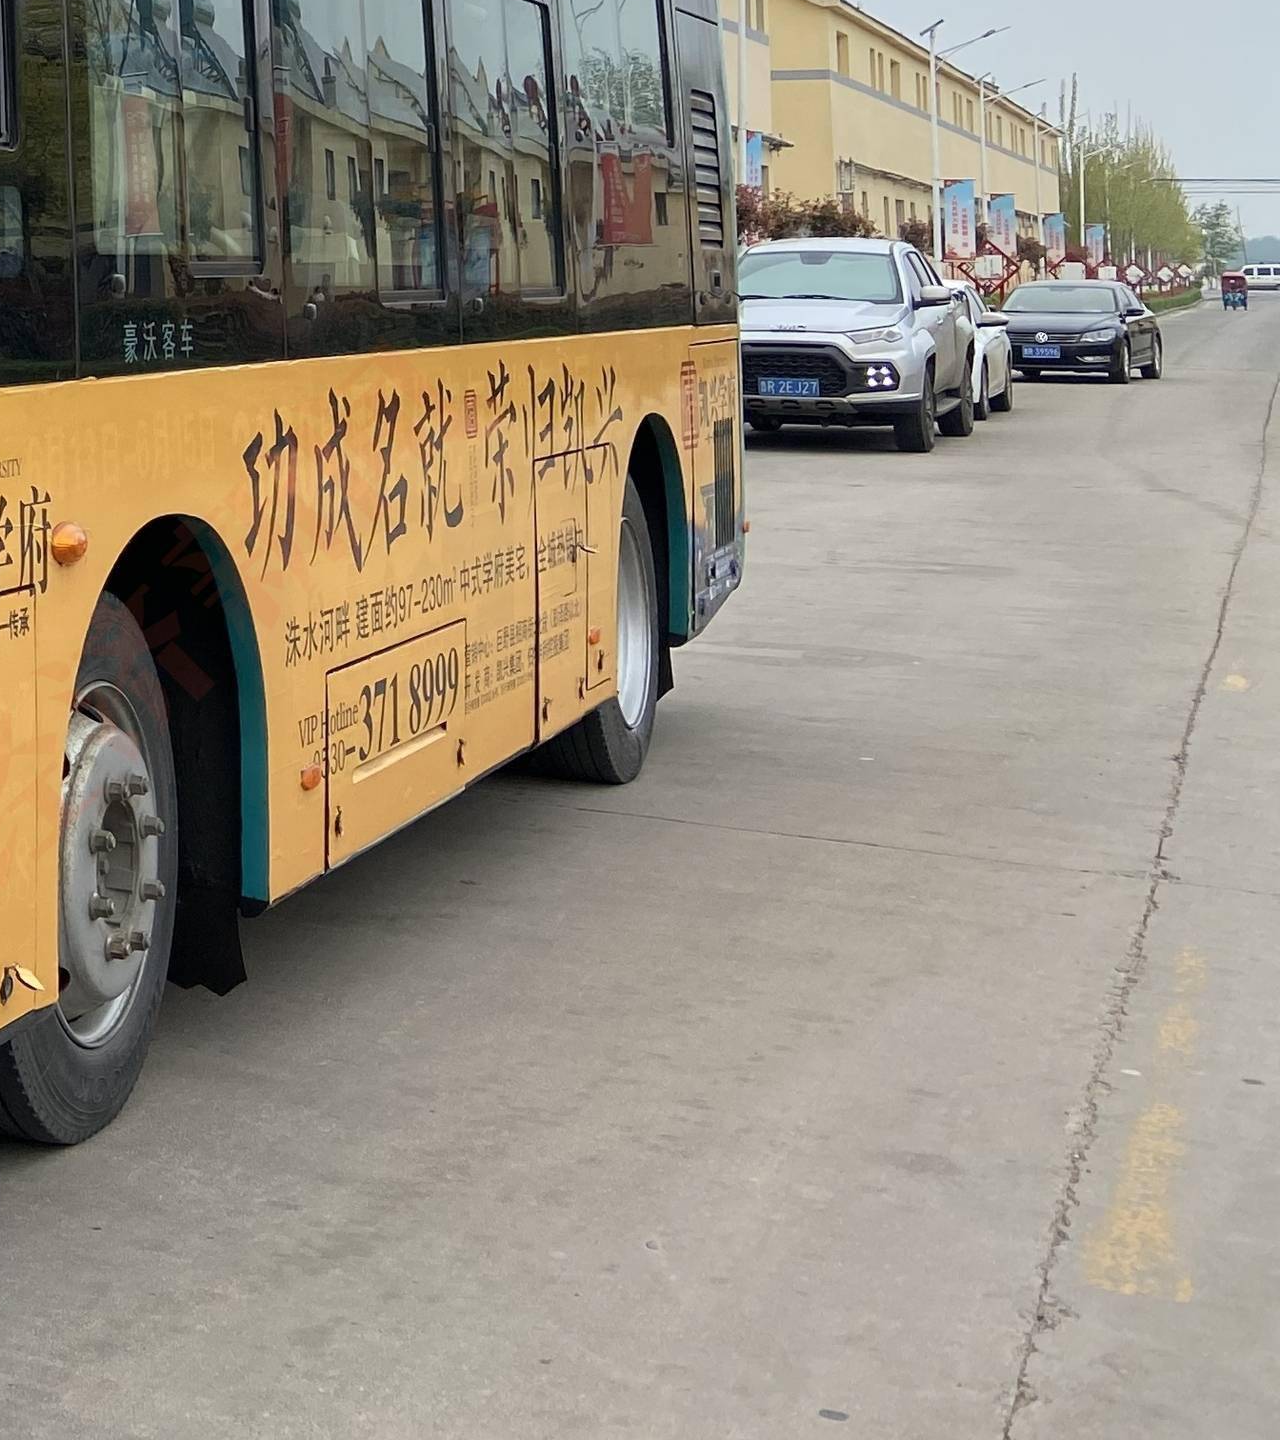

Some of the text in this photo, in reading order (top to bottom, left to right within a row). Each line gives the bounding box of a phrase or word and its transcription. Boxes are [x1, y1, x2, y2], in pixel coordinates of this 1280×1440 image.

[122, 319, 195, 364] 豪沃客车
[779, 380, 817, 396] 2EJ27
[242, 377, 464, 583] 功成名就
[486, 359, 623, 526] 荣归凯兴
[284, 600, 351, 668] 洙水河畔
[409, 647, 459, 735] 8999
[298, 702, 359, 748] VIP Hotline
